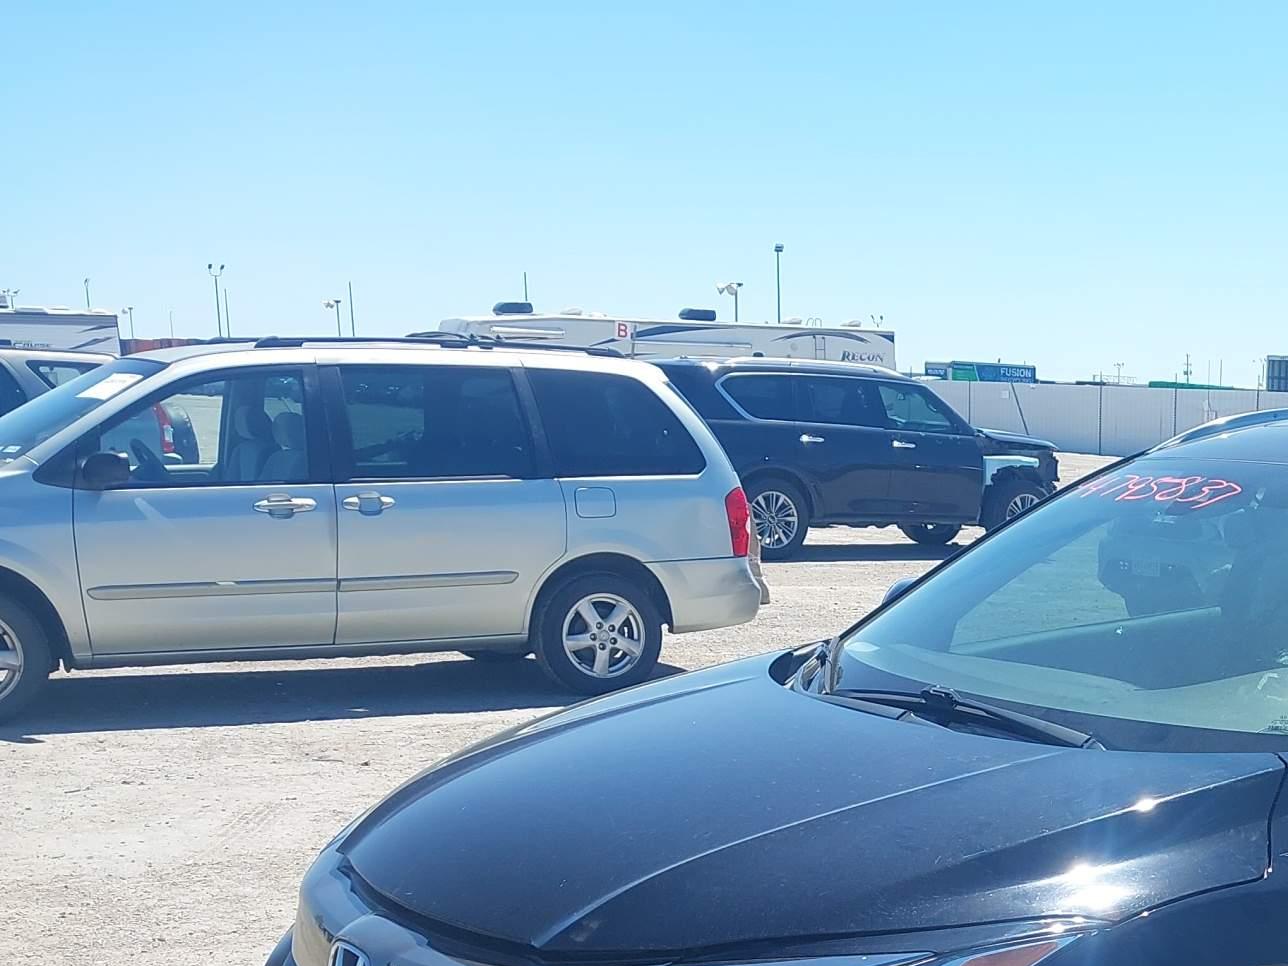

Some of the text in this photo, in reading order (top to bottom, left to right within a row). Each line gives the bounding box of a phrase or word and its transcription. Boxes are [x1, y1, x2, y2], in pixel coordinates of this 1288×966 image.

[617, 323, 628, 338] B
[840, 350, 884, 363] RECON
[1000, 367, 1032, 378] FUSION
